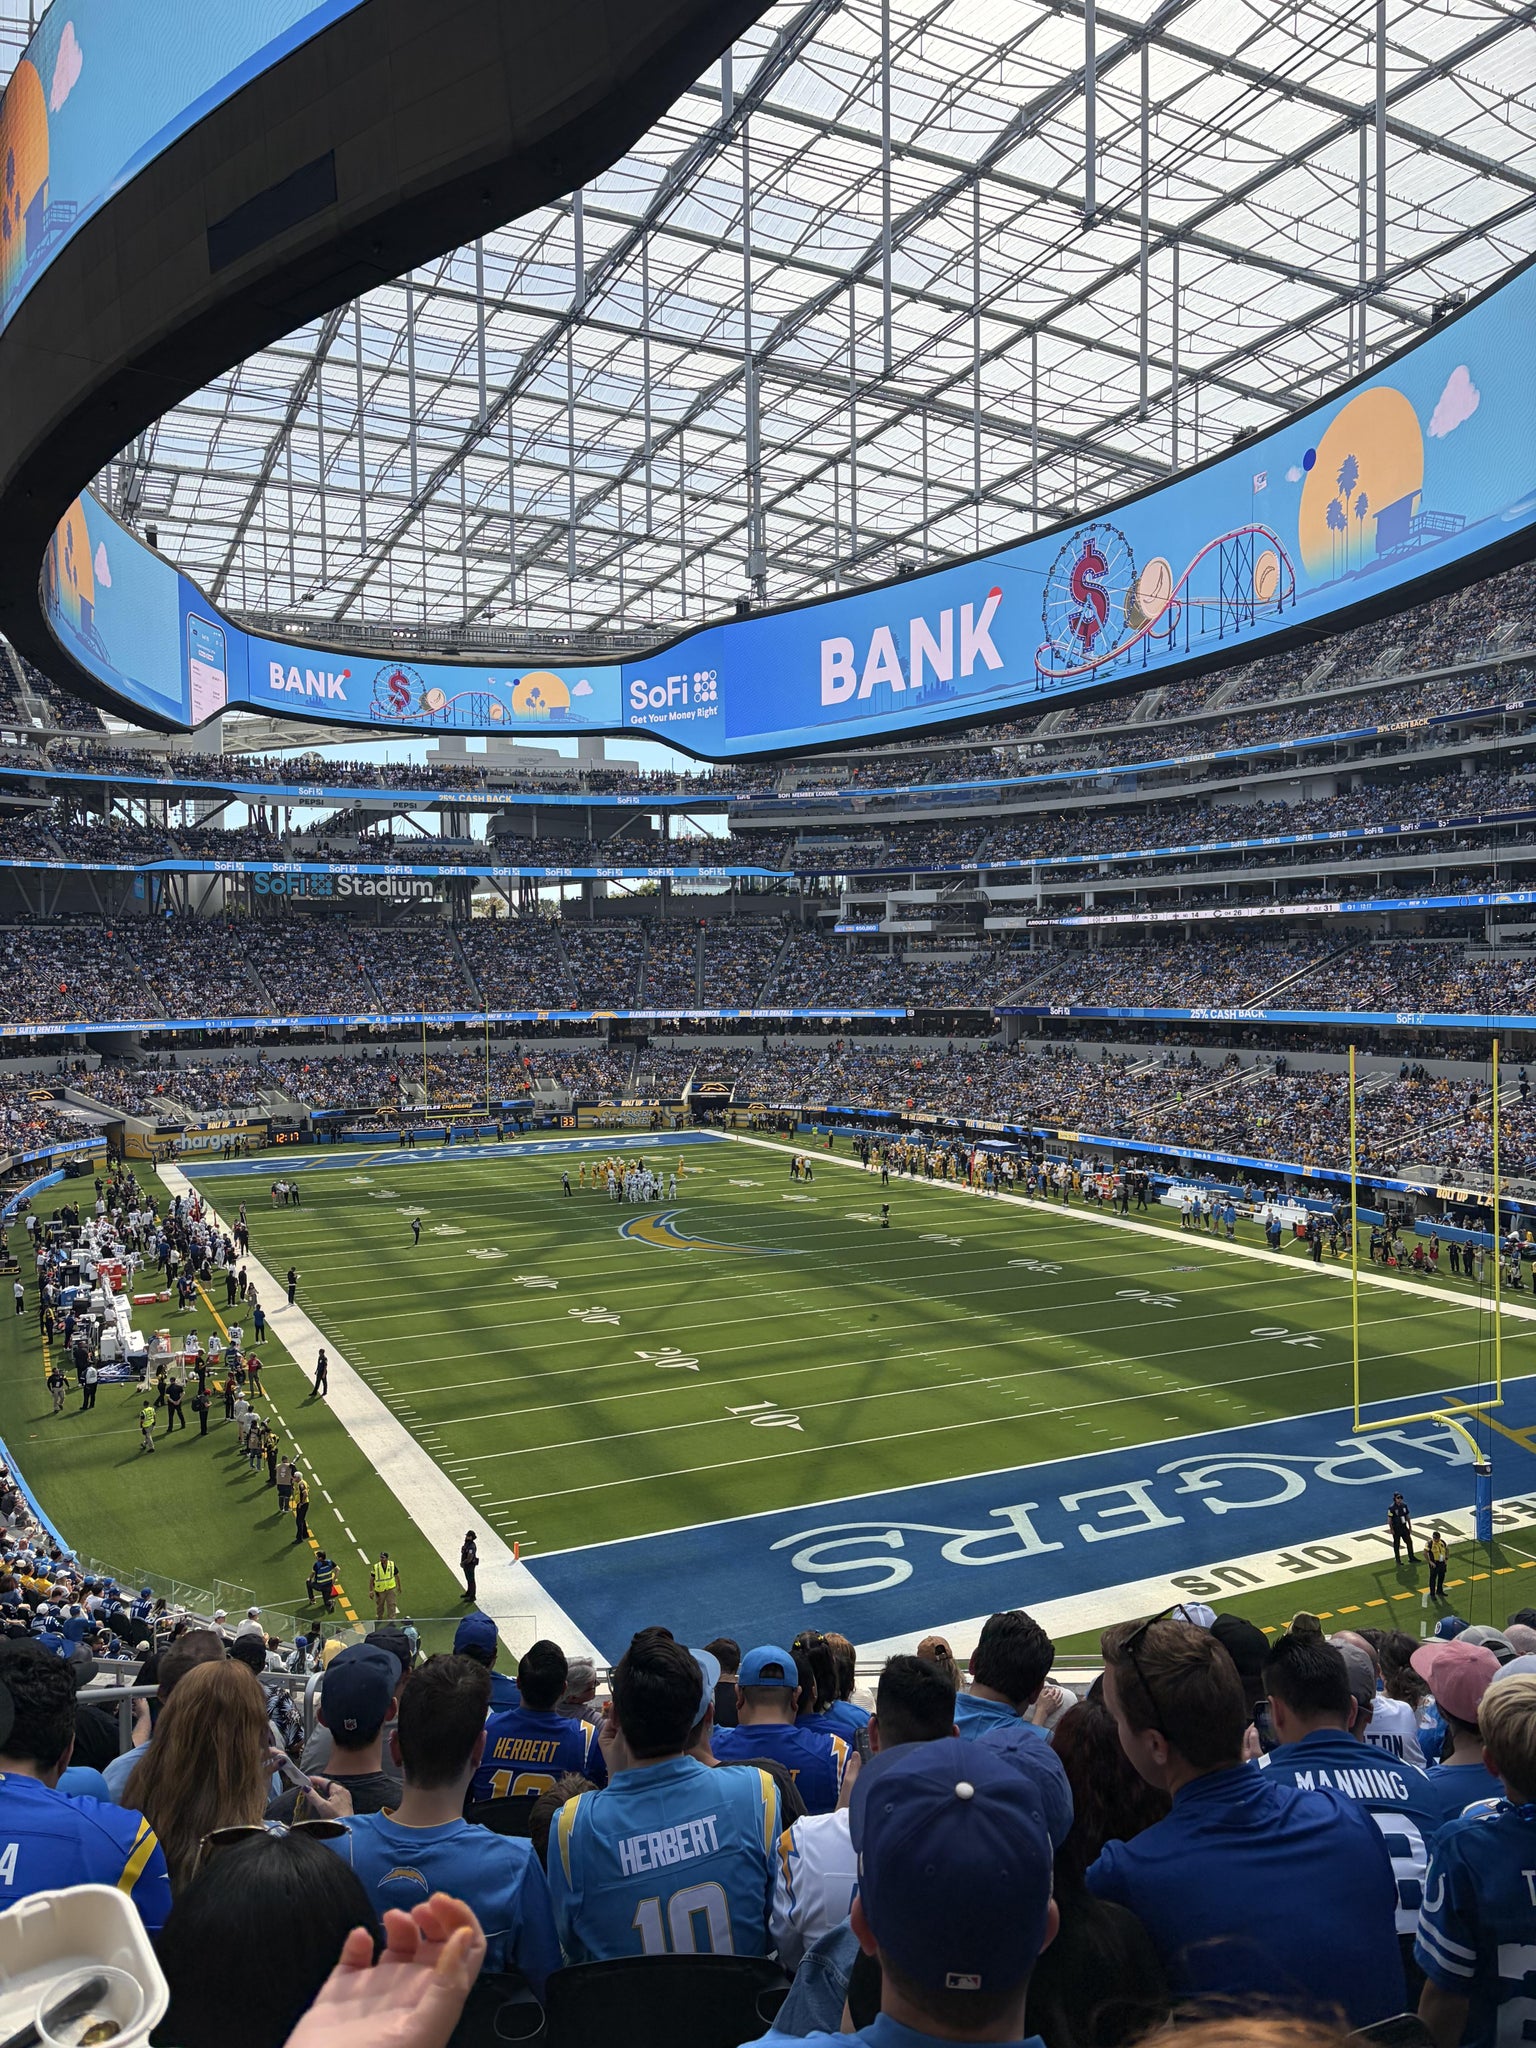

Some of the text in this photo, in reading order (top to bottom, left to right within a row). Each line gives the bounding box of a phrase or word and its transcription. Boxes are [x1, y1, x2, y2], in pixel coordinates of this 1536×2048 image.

[821, 586, 1004, 706] BANK
[269, 661, 350, 701] BANK
[630, 674, 689, 710] SoFi
[630, 704, 718, 726] Get Your Money Right
[298, 787, 315, 796] SoFi
[299, 798, 324, 806] PEPSI
[438, 794, 456, 802] 25%
[458, 794, 485, 802] CASH
[617, 796, 633, 804] SoFi
[392, 801, 417, 809] PEPSI
[1364, 827, 1378, 835] SoFi
[1400, 823, 1414, 831] SoFi
[1329, 830, 1342, 839] SoFi
[214, 861, 235, 871] SoFi
[272, 862, 292, 872] SoFi
[328, 864, 348, 873] SoFi
[383, 865, 403, 874] SoFi
[438, 866, 457, 875] SoFi
[492, 867, 511, 876] SoFi
[545, 868, 564, 877] SoFi
[596, 868, 615, 877] SoFi
[647, 868, 666, 876] SoFi
[698, 867, 716, 876] SoFi
[254, 873, 434, 897] SoFi Stadium
[1323, 904, 1333, 912] 31
[1050, 1007, 1063, 1015] SoFi
[1190, 1009, 1209, 1019] 25%
[1210, 1009, 1237, 1020] CASH
[1396, 1014, 1415, 1024] SoFi
[18, 1026, 37, 1034] SUITE
[36, 1025, 66, 1034] RENTALS
[207, 1122, 220, 1130] BOLT
[235, 1119, 248, 1127] LA
[563, 1116, 575, 1127] 33
[276, 1131, 299, 1143] 12:17
[1436, 1188, 1454, 1200] BOLT
[1456, 1190, 1468, 1202] UP
[1115, 1289, 1183, 1309] 20
[567, 1306, 621, 1325] 30
[230, 1331, 239, 1339] 12
[1249, 1326, 1326, 1350] 10
[634, 1346, 700, 1370] 20
[724, 1400, 802, 1429] 10
[1275, 1545, 1353, 1574] OF
[1170, 1565, 1265, 1596] US
[493, 1737, 560, 1763] HERBERT
[1363, 1734, 1404, 1759] TON
[1294, 1768, 1409, 1801] MANNING
[618, 1814, 722, 1877] HERBERT
[632, 1881, 737, 1955] 10
